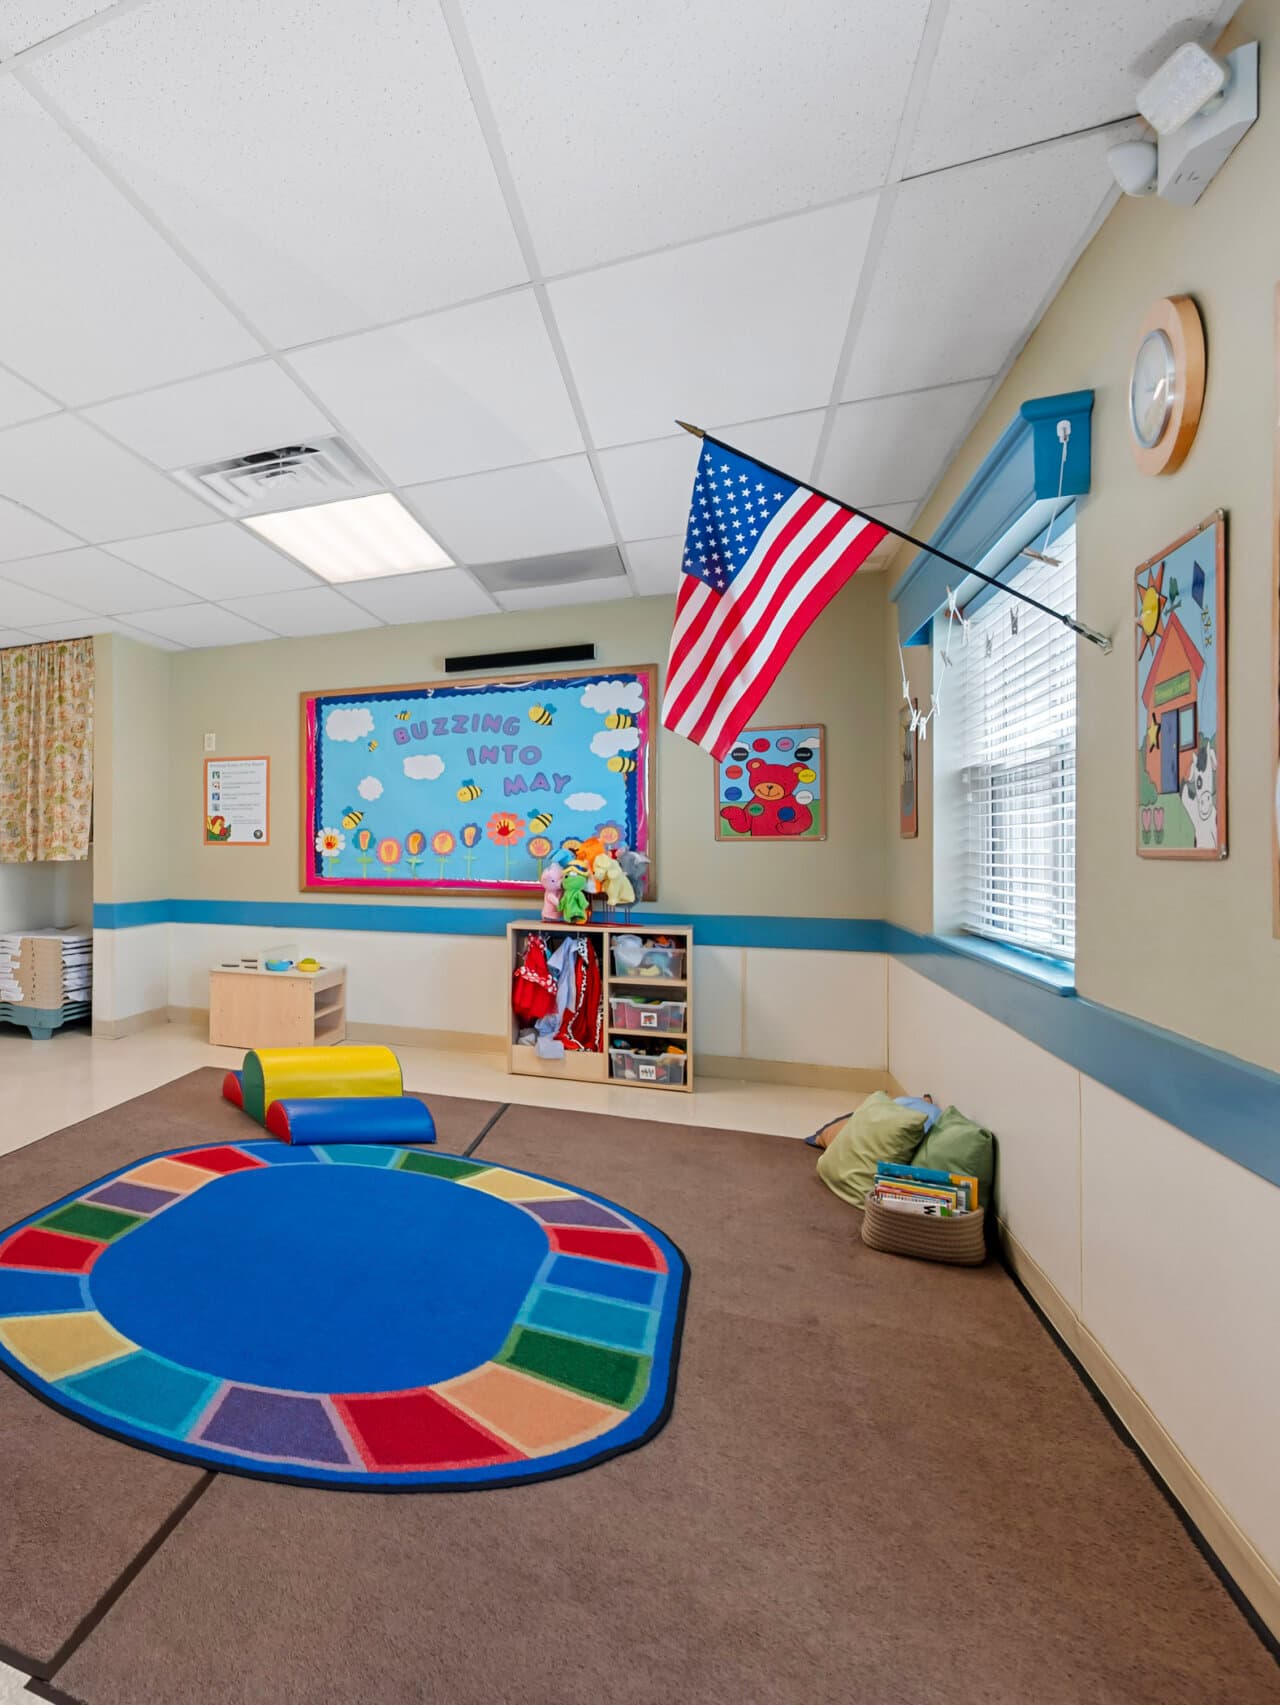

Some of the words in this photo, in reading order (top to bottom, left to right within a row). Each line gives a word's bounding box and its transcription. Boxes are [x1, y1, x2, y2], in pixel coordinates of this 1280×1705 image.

[393, 714, 520, 745] BUZZING
[467, 745, 542, 765] INTO
[503, 772, 571, 797] MAY
